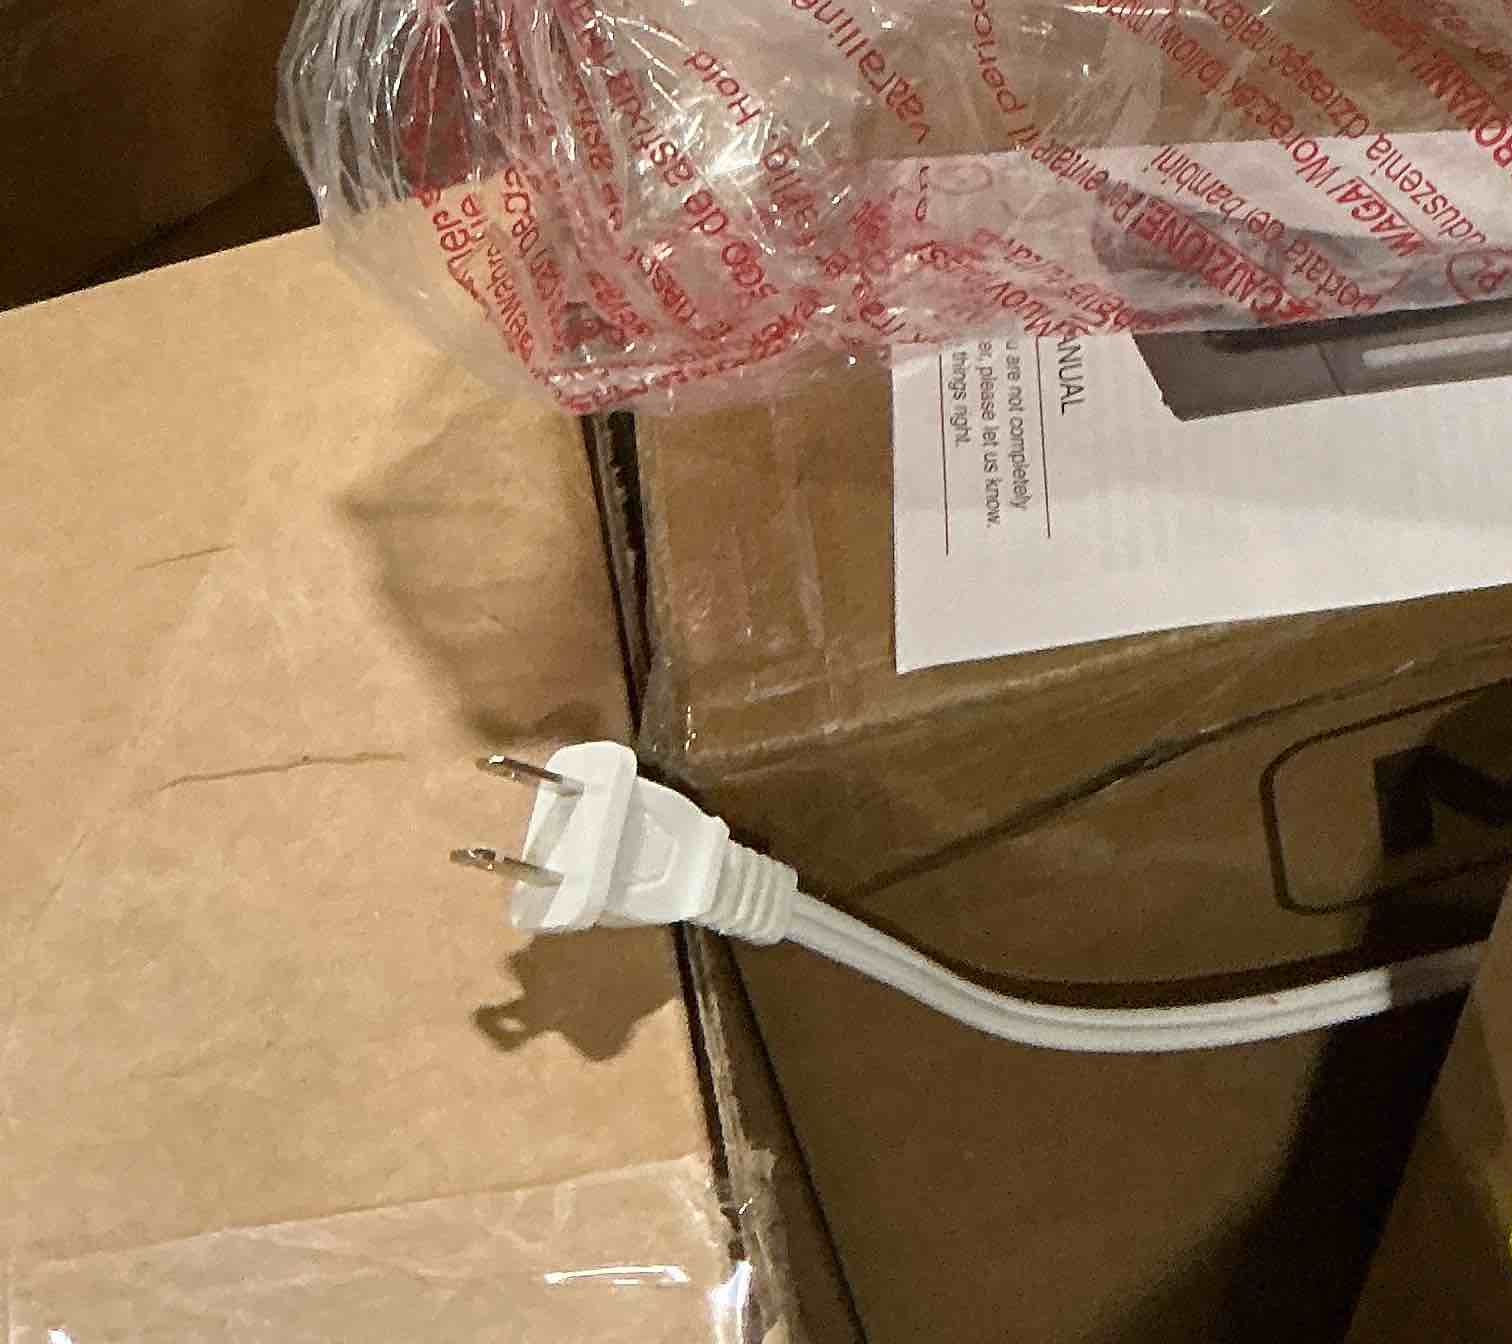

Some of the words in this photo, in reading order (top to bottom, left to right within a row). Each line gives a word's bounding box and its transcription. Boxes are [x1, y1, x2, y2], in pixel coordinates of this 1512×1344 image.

[948, 352, 970, 401] things
[1005, 354, 1021, 381] are
[1057, 336, 1084, 415] ANUAL
[976, 367, 997, 421] please
[1007, 386, 1029, 412] not
[982, 426, 999, 447] let
[983, 451, 997, 472] us
[1005, 416, 1032, 511] completely
[985, 477, 1001, 527] know.
